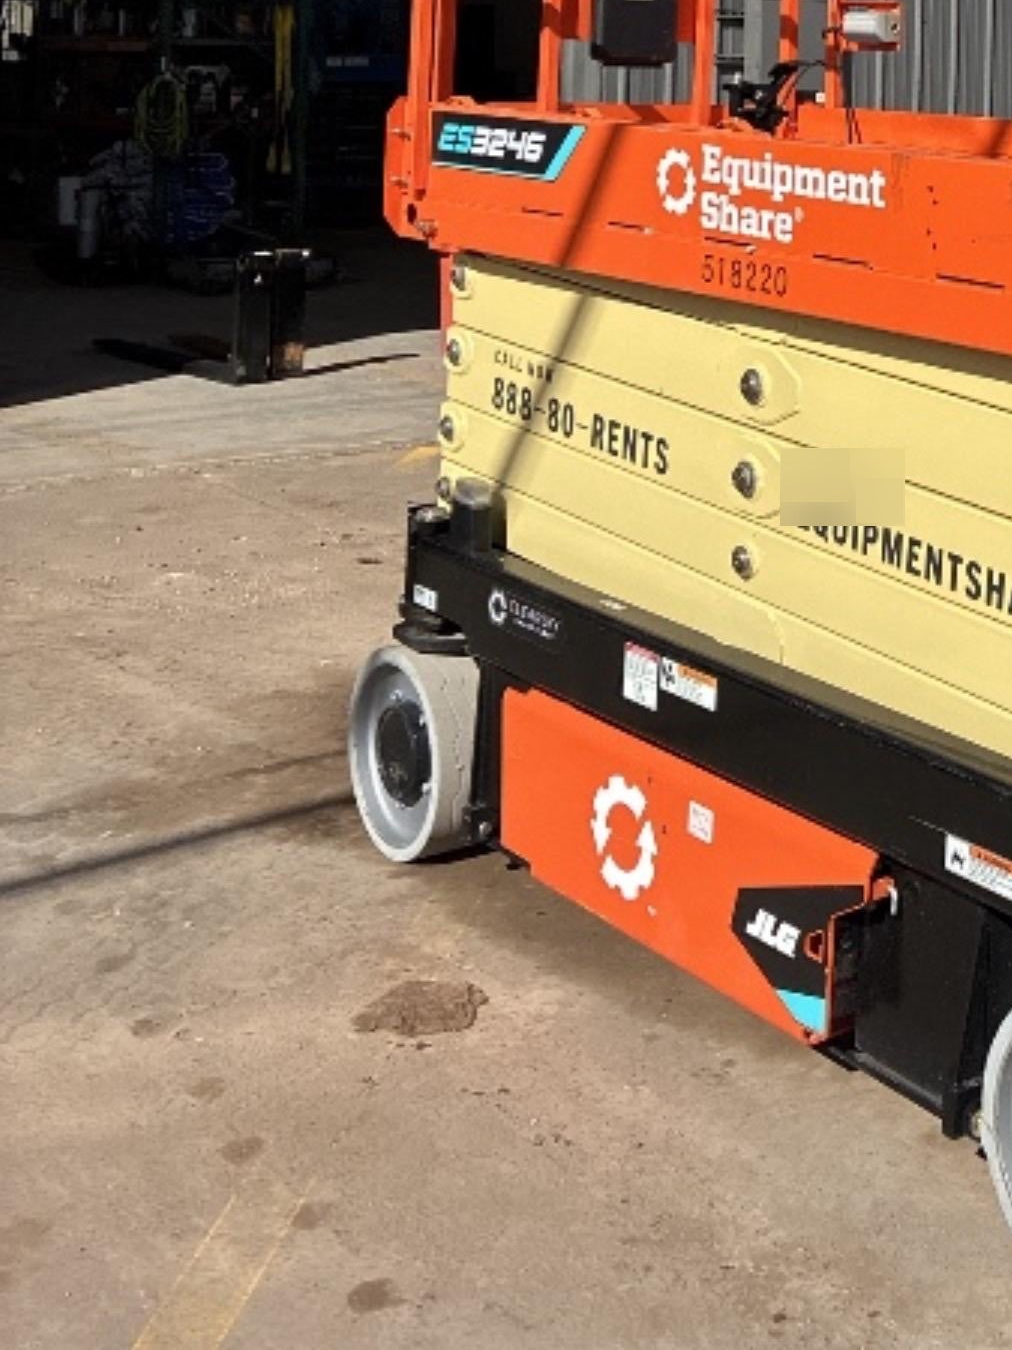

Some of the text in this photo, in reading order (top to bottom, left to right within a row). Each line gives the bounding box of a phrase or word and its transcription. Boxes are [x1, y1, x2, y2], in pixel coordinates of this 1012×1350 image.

[701, 144, 887, 208] Equipment
[701, 253, 788, 298] 518220
[491, 377, 671, 476] 888-80-RENTS
[745, 907, 801, 959] JLG
